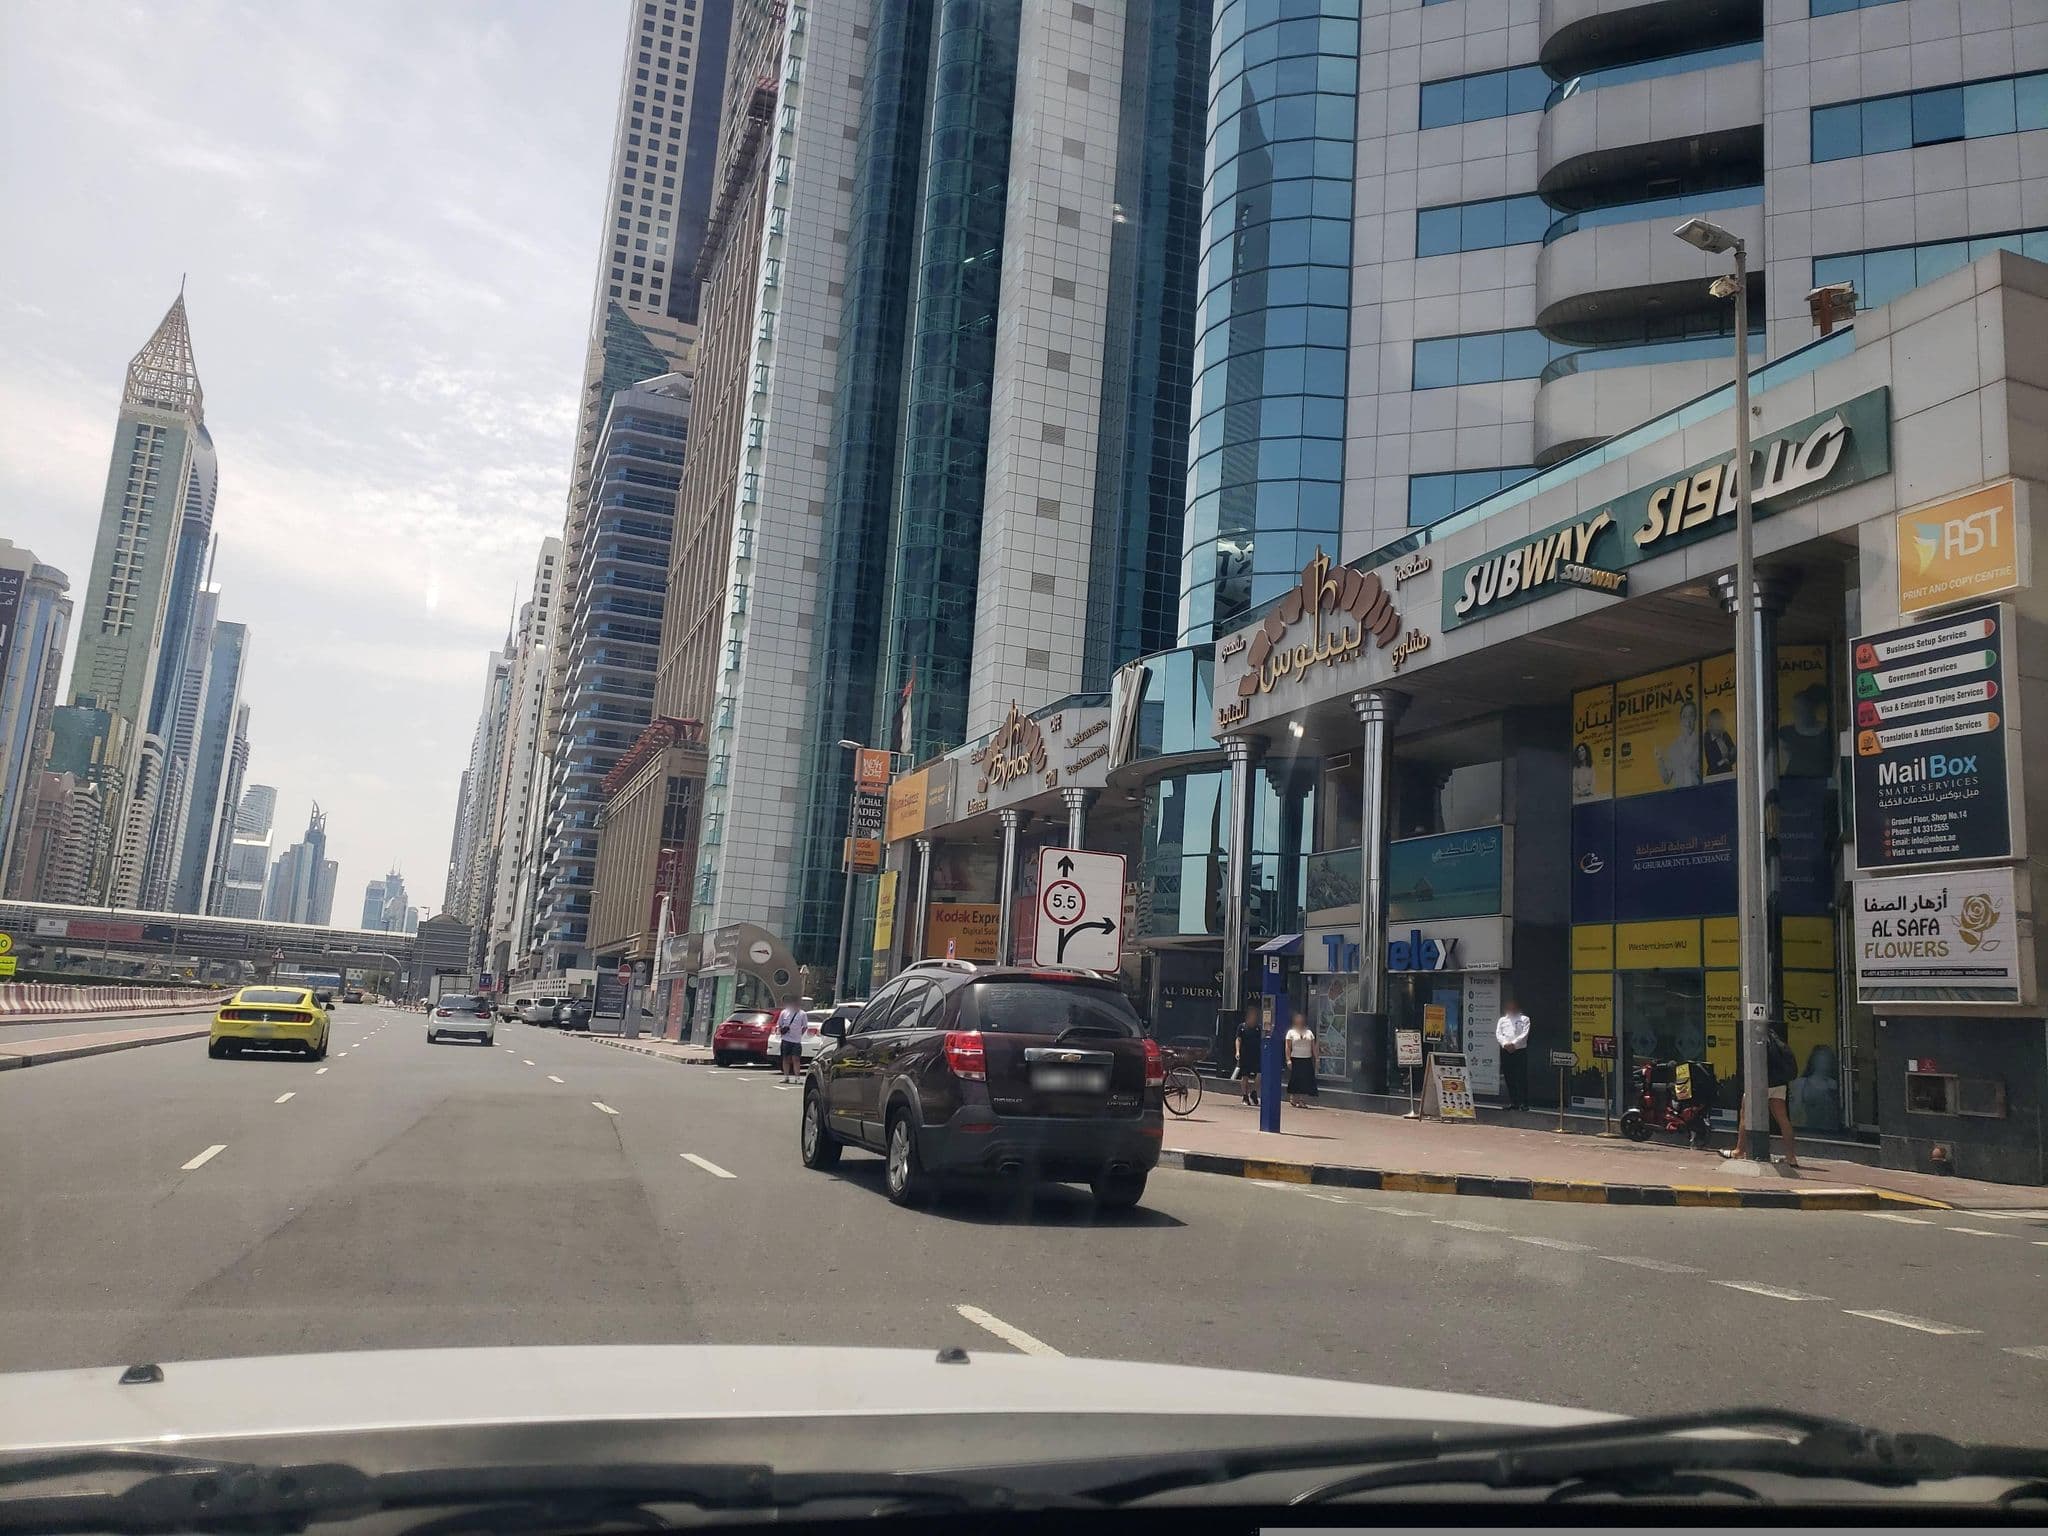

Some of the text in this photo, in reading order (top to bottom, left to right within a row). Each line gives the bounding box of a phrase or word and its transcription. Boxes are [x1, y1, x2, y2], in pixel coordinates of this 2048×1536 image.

[1454, 511, 1611, 618] SUBWAY
[1560, 563, 1627, 590] SUBWAY
[1903, 566, 2012, 601] PRINT AND COPY CENTRE
[1886, 629, 1967, 655] Business Setup Services
[1888, 662, 1957, 684] Government Services
[1617, 683, 1695, 718] PILIPINAS
[1880, 687, 1984, 714] Visa & Emirates ID Typing Services
[1575, 705, 1613, 734] لبنان
[1880, 718, 1982, 743] Translation & Attestation Services
[1878, 777, 1979, 797] SMART SERVICES
[1878, 788, 1979, 809] ميل بوكس للخدمات الذكية
[1891, 817, 1912, 826] Ground
[1931, 813, 1947, 822] Shop
[1913, 826, 1920, 834] 04
[1922, 823, 1949, 833] 3312555
[1692, 854, 1730, 864] EXCHANGE
[1053, 895, 1076, 909] 5.5
[1864, 888, 1948, 913] أزهار الصفا
[936, 909, 1000, 926] Kodak Expre
[1872, 918, 1940, 937] AL SAFA
[1323, 929, 1459, 972] Trelex
[1864, 940, 1949, 959] FLOWERS
[1271, 962, 1278, 970] P
